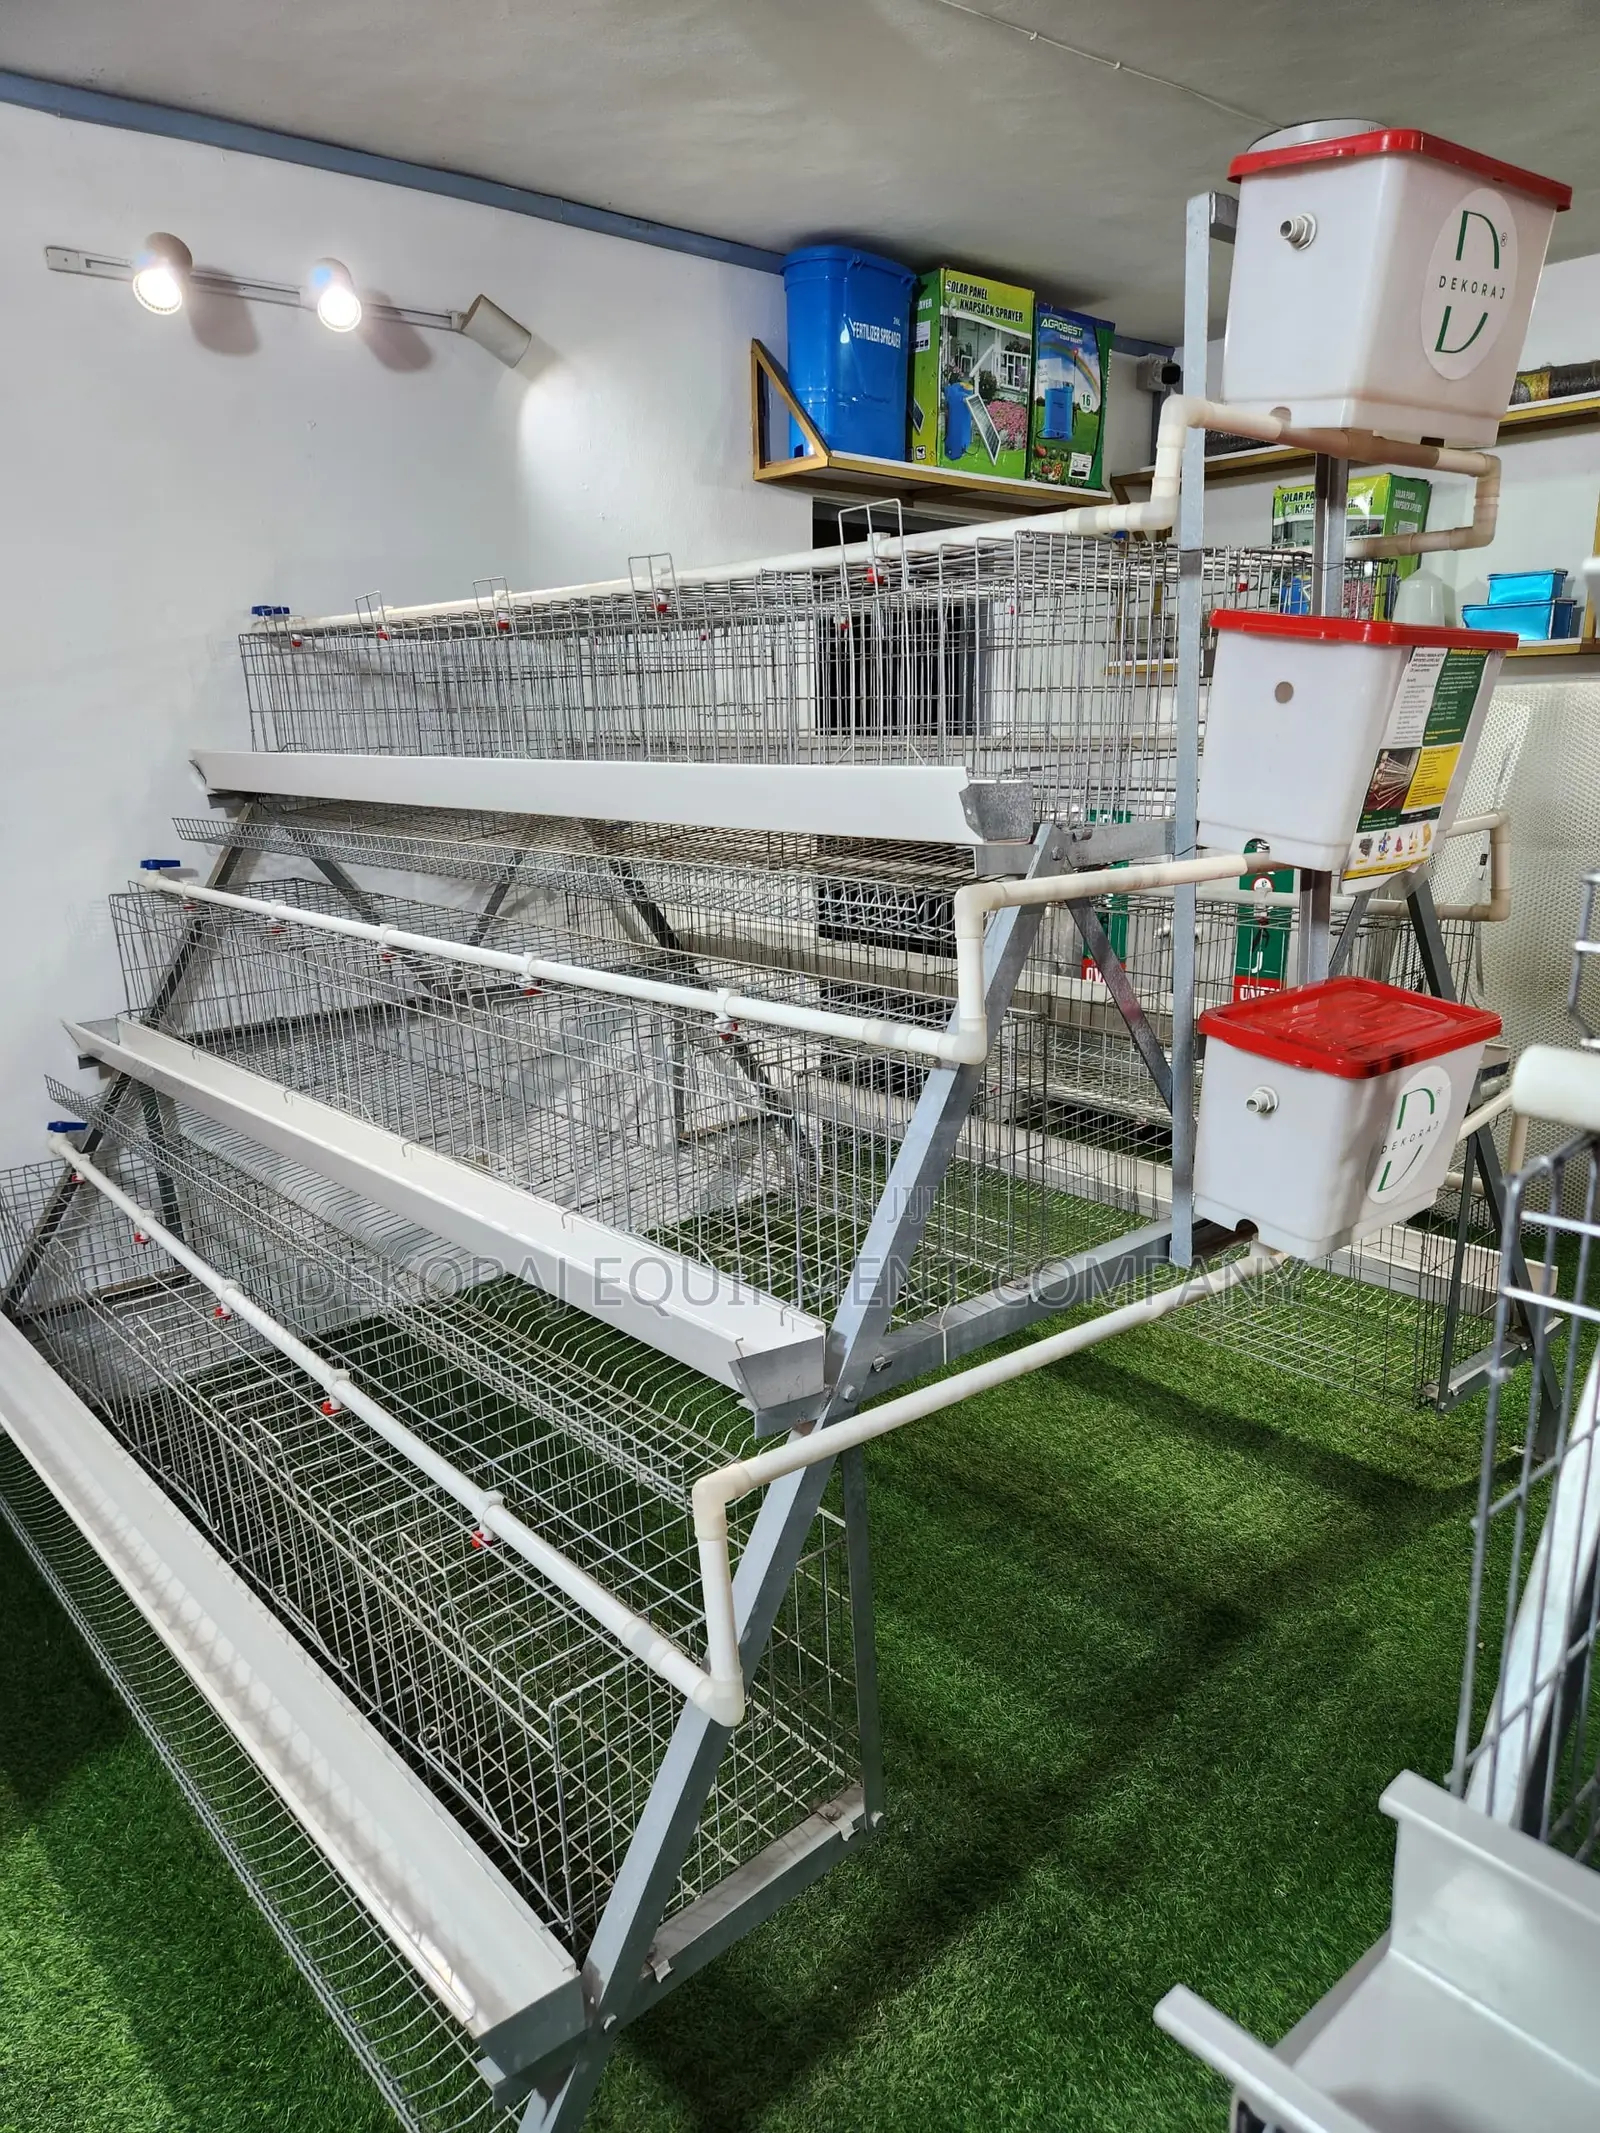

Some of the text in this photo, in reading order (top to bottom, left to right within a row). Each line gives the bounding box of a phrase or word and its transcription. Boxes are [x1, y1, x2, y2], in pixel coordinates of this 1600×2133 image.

[946, 280, 968, 295] SOLAR
[968, 285, 988, 301] PANEL
[1438, 275, 1506, 300] DEKORAJ
[959, 299, 1024, 323] KNAPSACK SPRAYER
[853, 322, 881, 343] FERTILIZER
[1041, 318, 1083, 337] AGROBEST
[1082, 394, 1091, 406] 16
[1380, 1120, 1440, 1155] DEKORAJ
